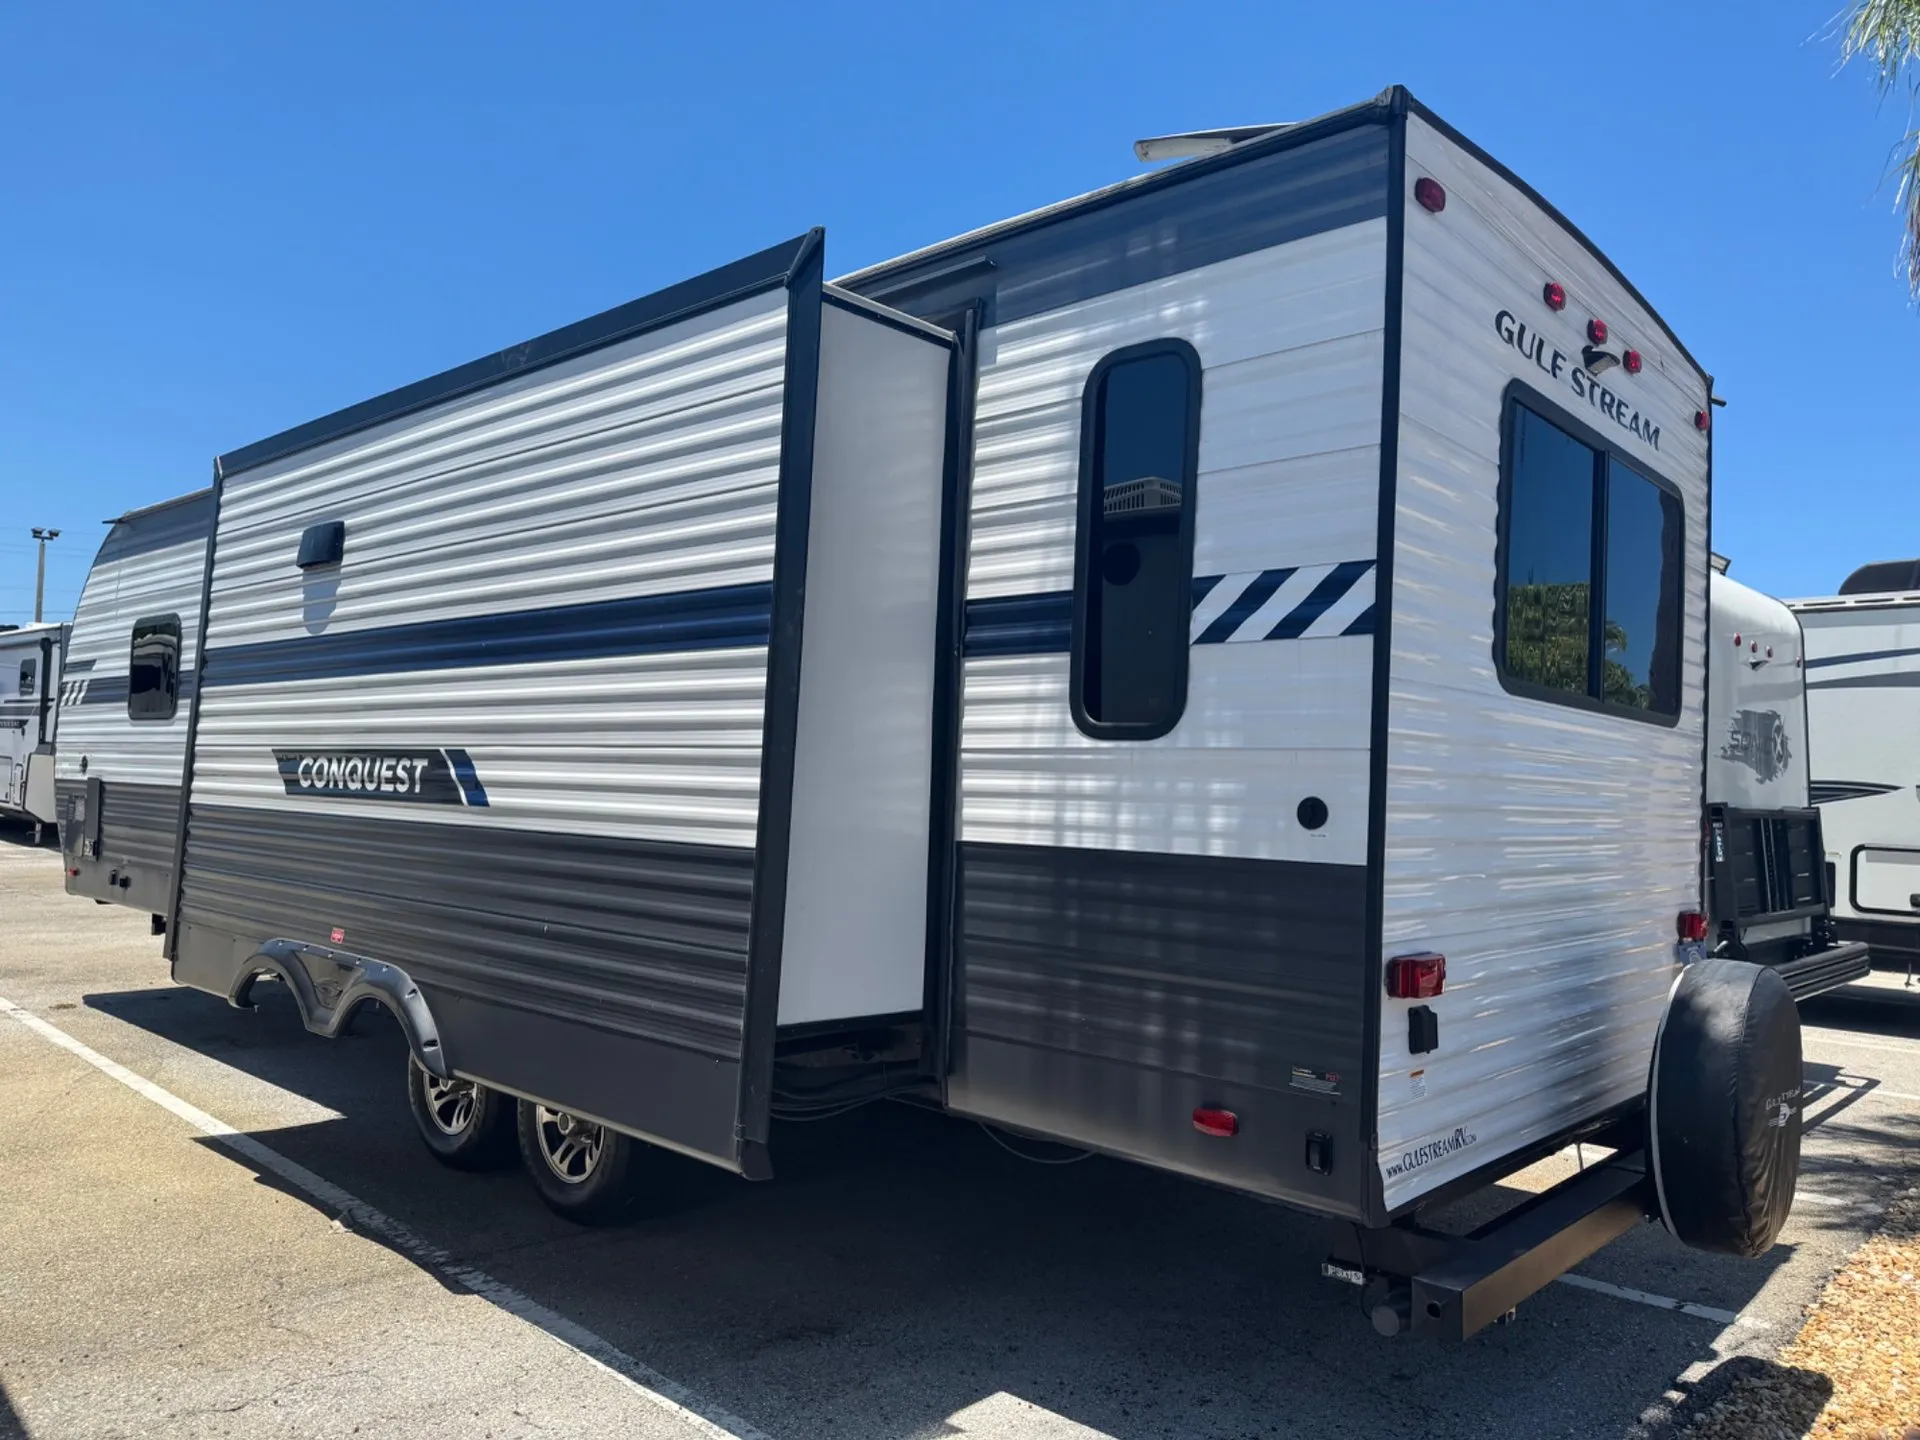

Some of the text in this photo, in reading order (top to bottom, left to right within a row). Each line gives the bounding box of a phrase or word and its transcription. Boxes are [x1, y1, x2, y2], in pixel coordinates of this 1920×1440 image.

[1495, 310, 1661, 451] GULF STREAM
[298, 756, 428, 794] CONQUEST
